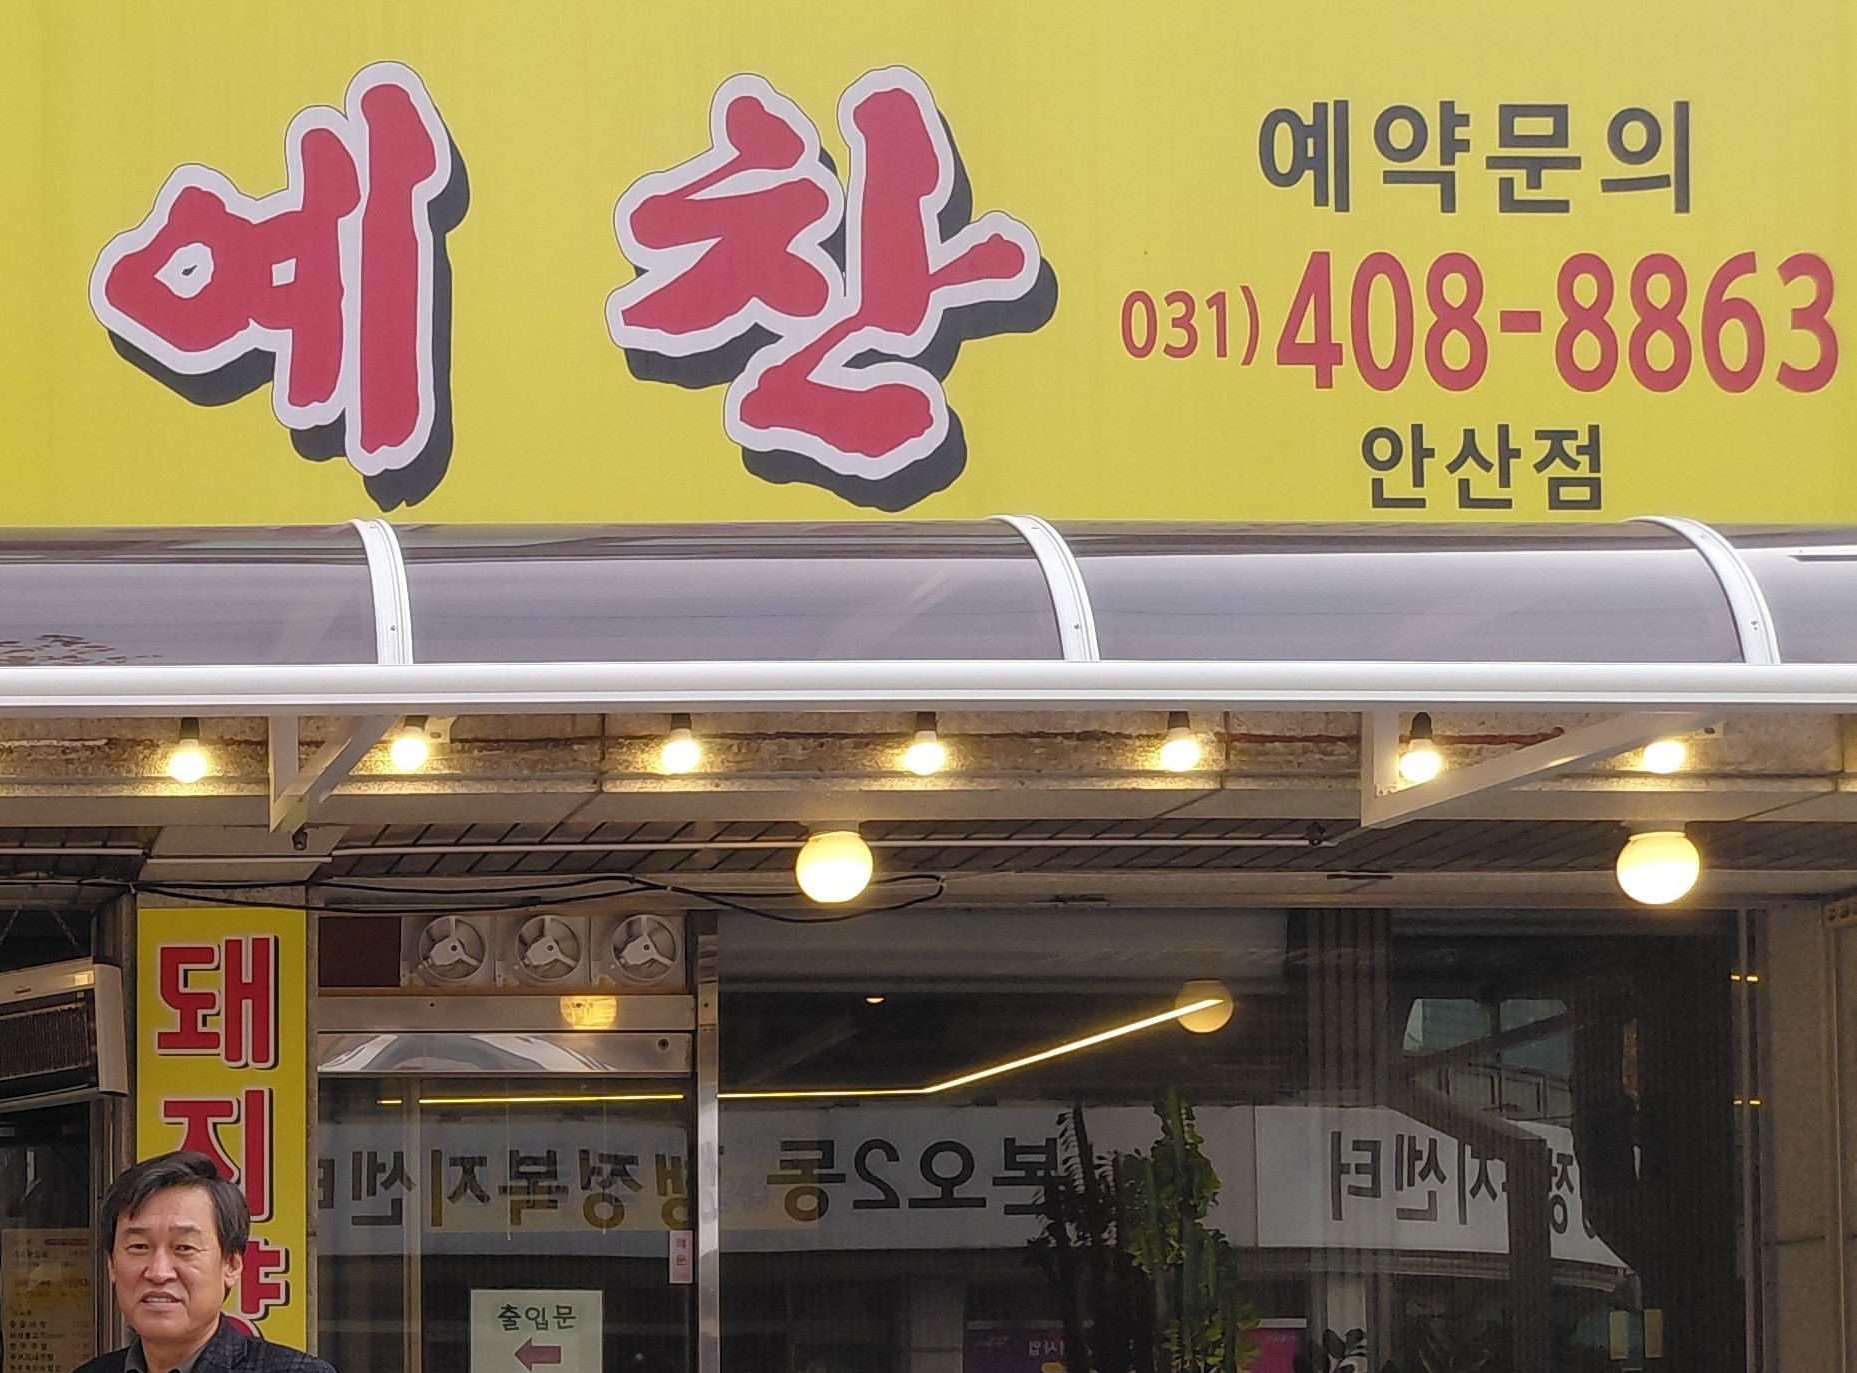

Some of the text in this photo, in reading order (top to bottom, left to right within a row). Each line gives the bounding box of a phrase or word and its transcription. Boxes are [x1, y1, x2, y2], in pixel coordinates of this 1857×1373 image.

[1258, 100, 1691, 214] 예약문의
[1362, 423, 1603, 512] 안산점
[497, 1304, 577, 1331] 출입문
